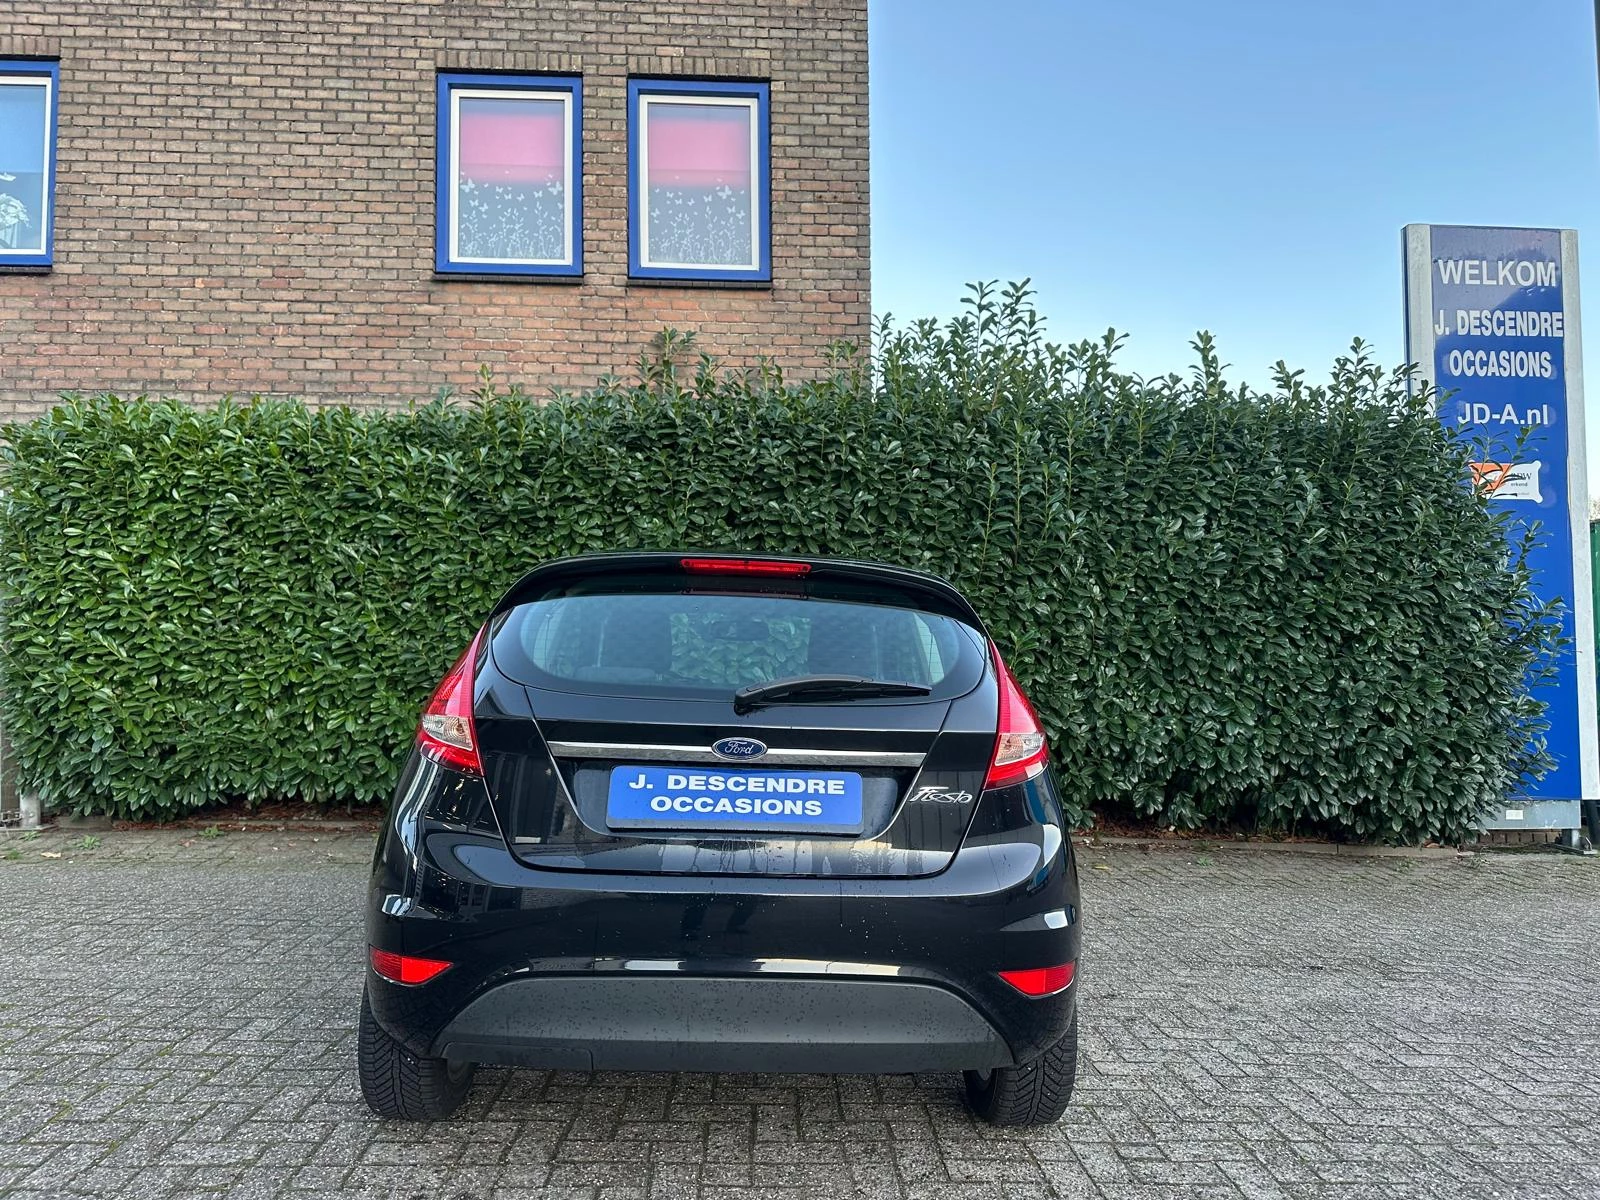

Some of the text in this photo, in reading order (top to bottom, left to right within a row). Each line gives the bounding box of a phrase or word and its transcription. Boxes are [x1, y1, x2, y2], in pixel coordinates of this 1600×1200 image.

[1438, 259, 1556, 287] WELKOM
[1434, 309, 1564, 337] J. DESCENDRE
[1449, 349, 1552, 378] OCCASIONS
[1457, 403, 1548, 425] JD-A.nl
[724, 740, 755, 754] Ford
[628, 774, 845, 795] J. DESCENDRE
[909, 786, 973, 804] Fiesta
[650, 796, 823, 816] OCCASIONS
